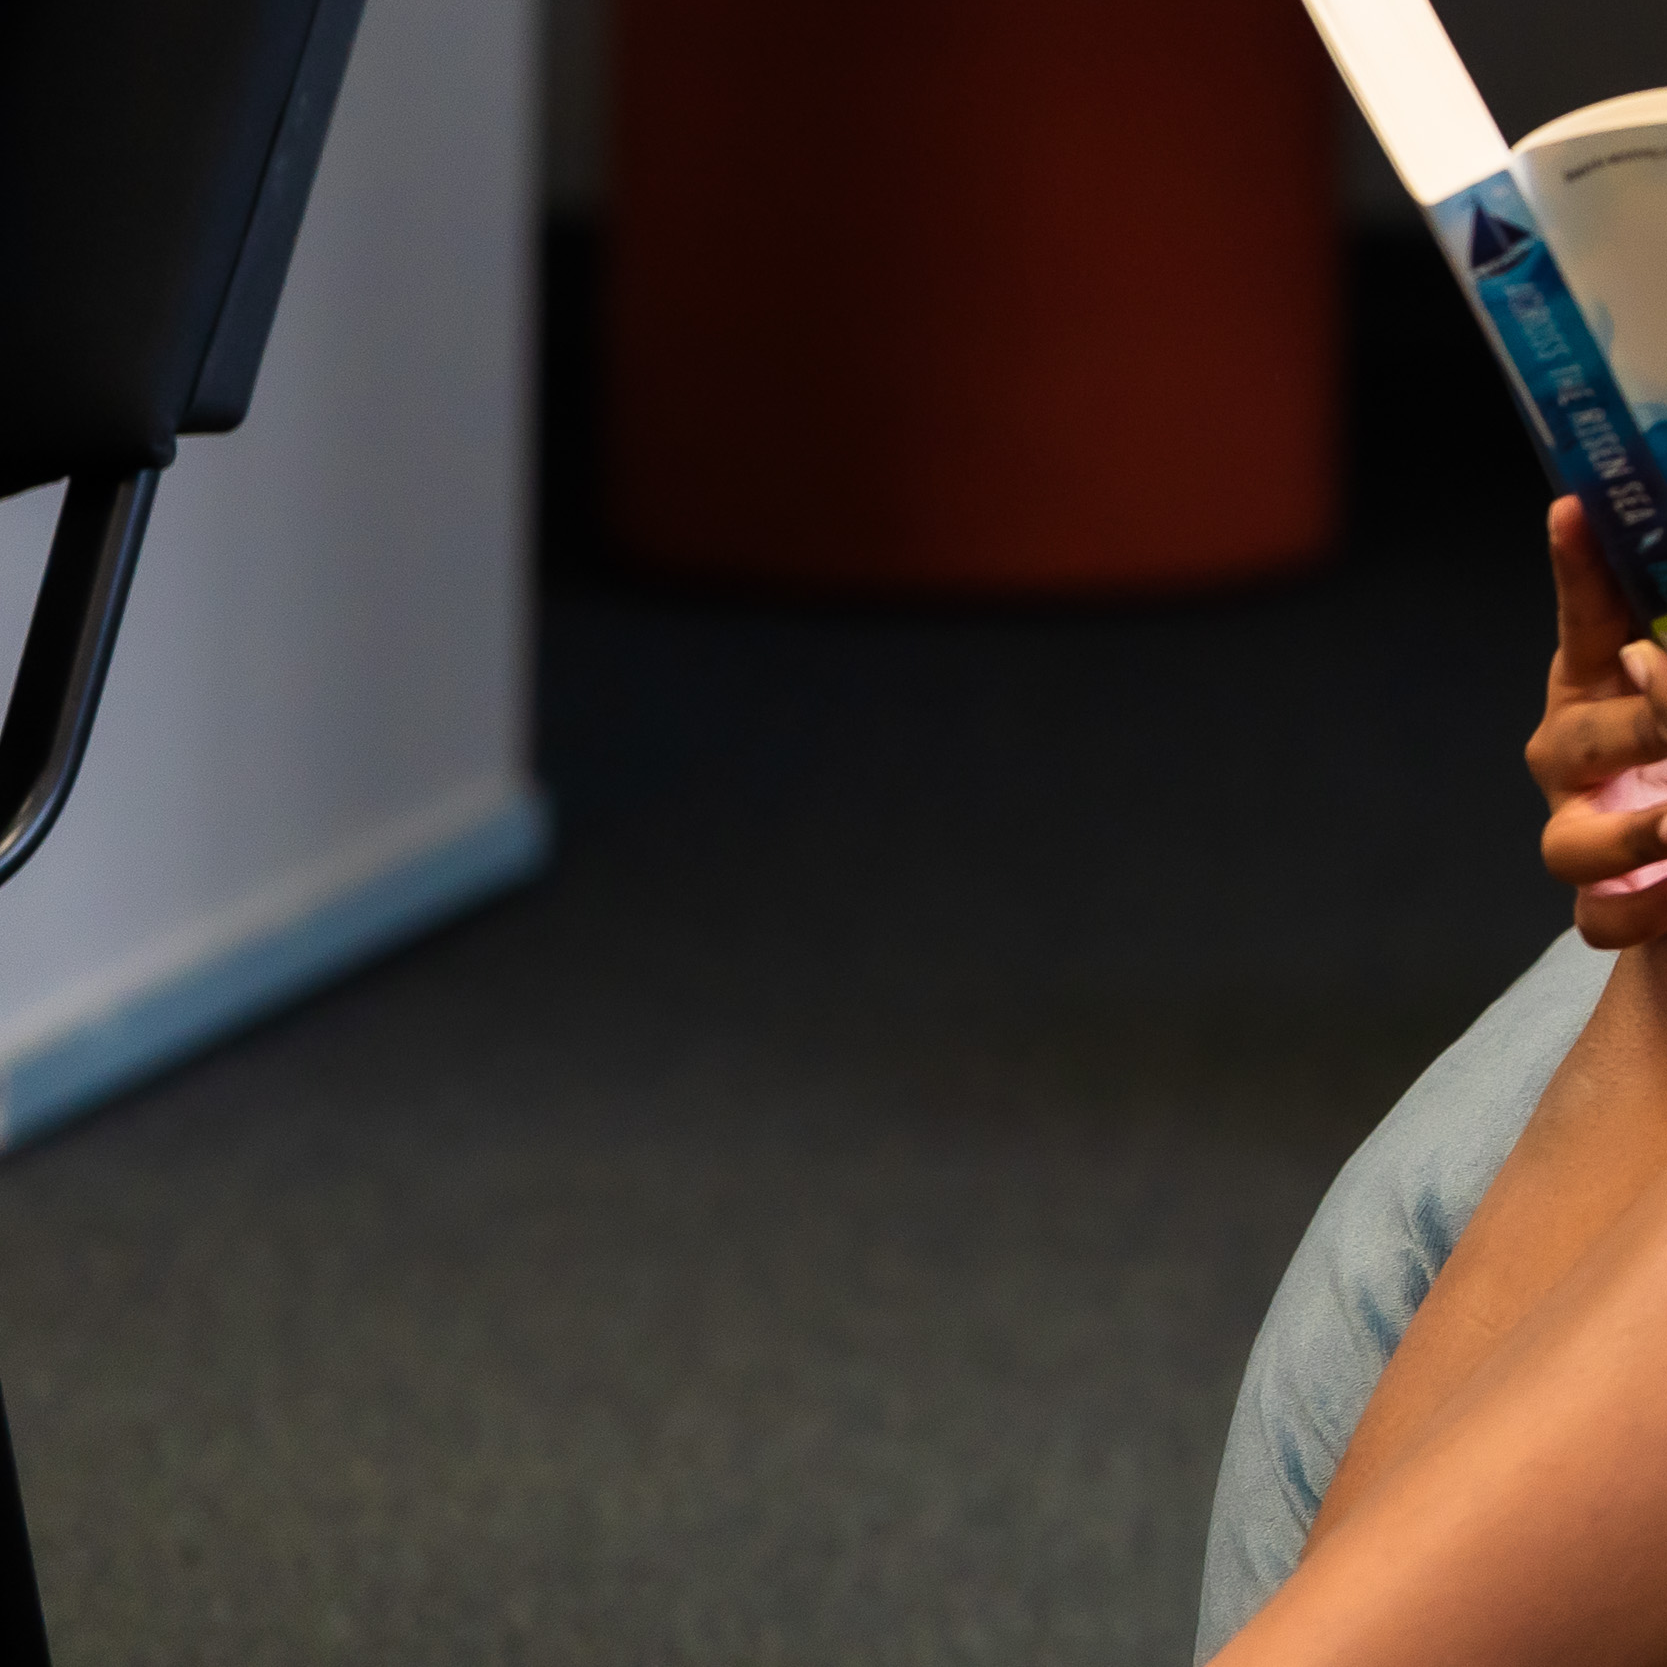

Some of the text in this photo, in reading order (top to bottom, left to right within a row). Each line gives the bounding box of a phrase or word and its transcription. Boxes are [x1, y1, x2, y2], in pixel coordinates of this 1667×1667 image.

[1503, 282, 1656, 526] ACROSS THE RISEN SEA
